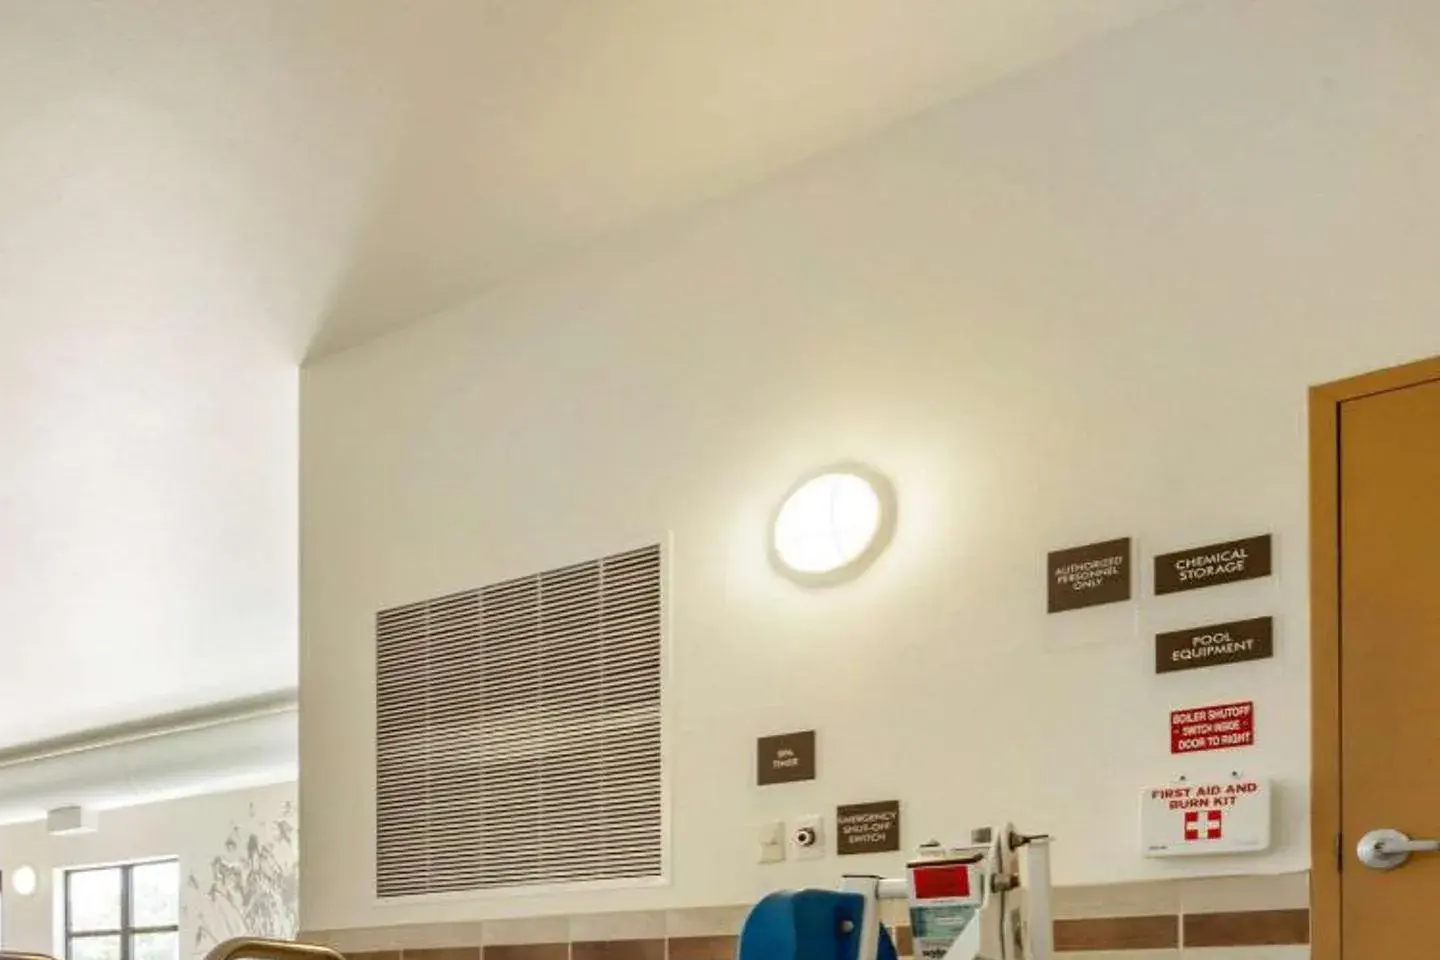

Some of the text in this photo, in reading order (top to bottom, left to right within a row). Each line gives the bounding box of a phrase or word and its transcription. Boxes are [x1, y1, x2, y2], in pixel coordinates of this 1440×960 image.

[1055, 556, 1123, 576] AUTHORIZED
[1175, 548, 1249, 571] CHEMICAL
[1057, 566, 1119, 584] PERSONNEL
[1178, 560, 1245, 581] STORAGE
[1072, 577, 1103, 591] ONLY
[1191, 631, 1232, 647] POOL
[1171, 639, 1254, 662] EQUIPMENT
[1172, 705, 1251, 725] BOILER SHUTOFF
[1178, 732, 1250, 750] DOOR TO RIGHT
[1151, 783, 1258, 800] FIRST AID AND
[1169, 796, 1236, 810] BURN KIT
